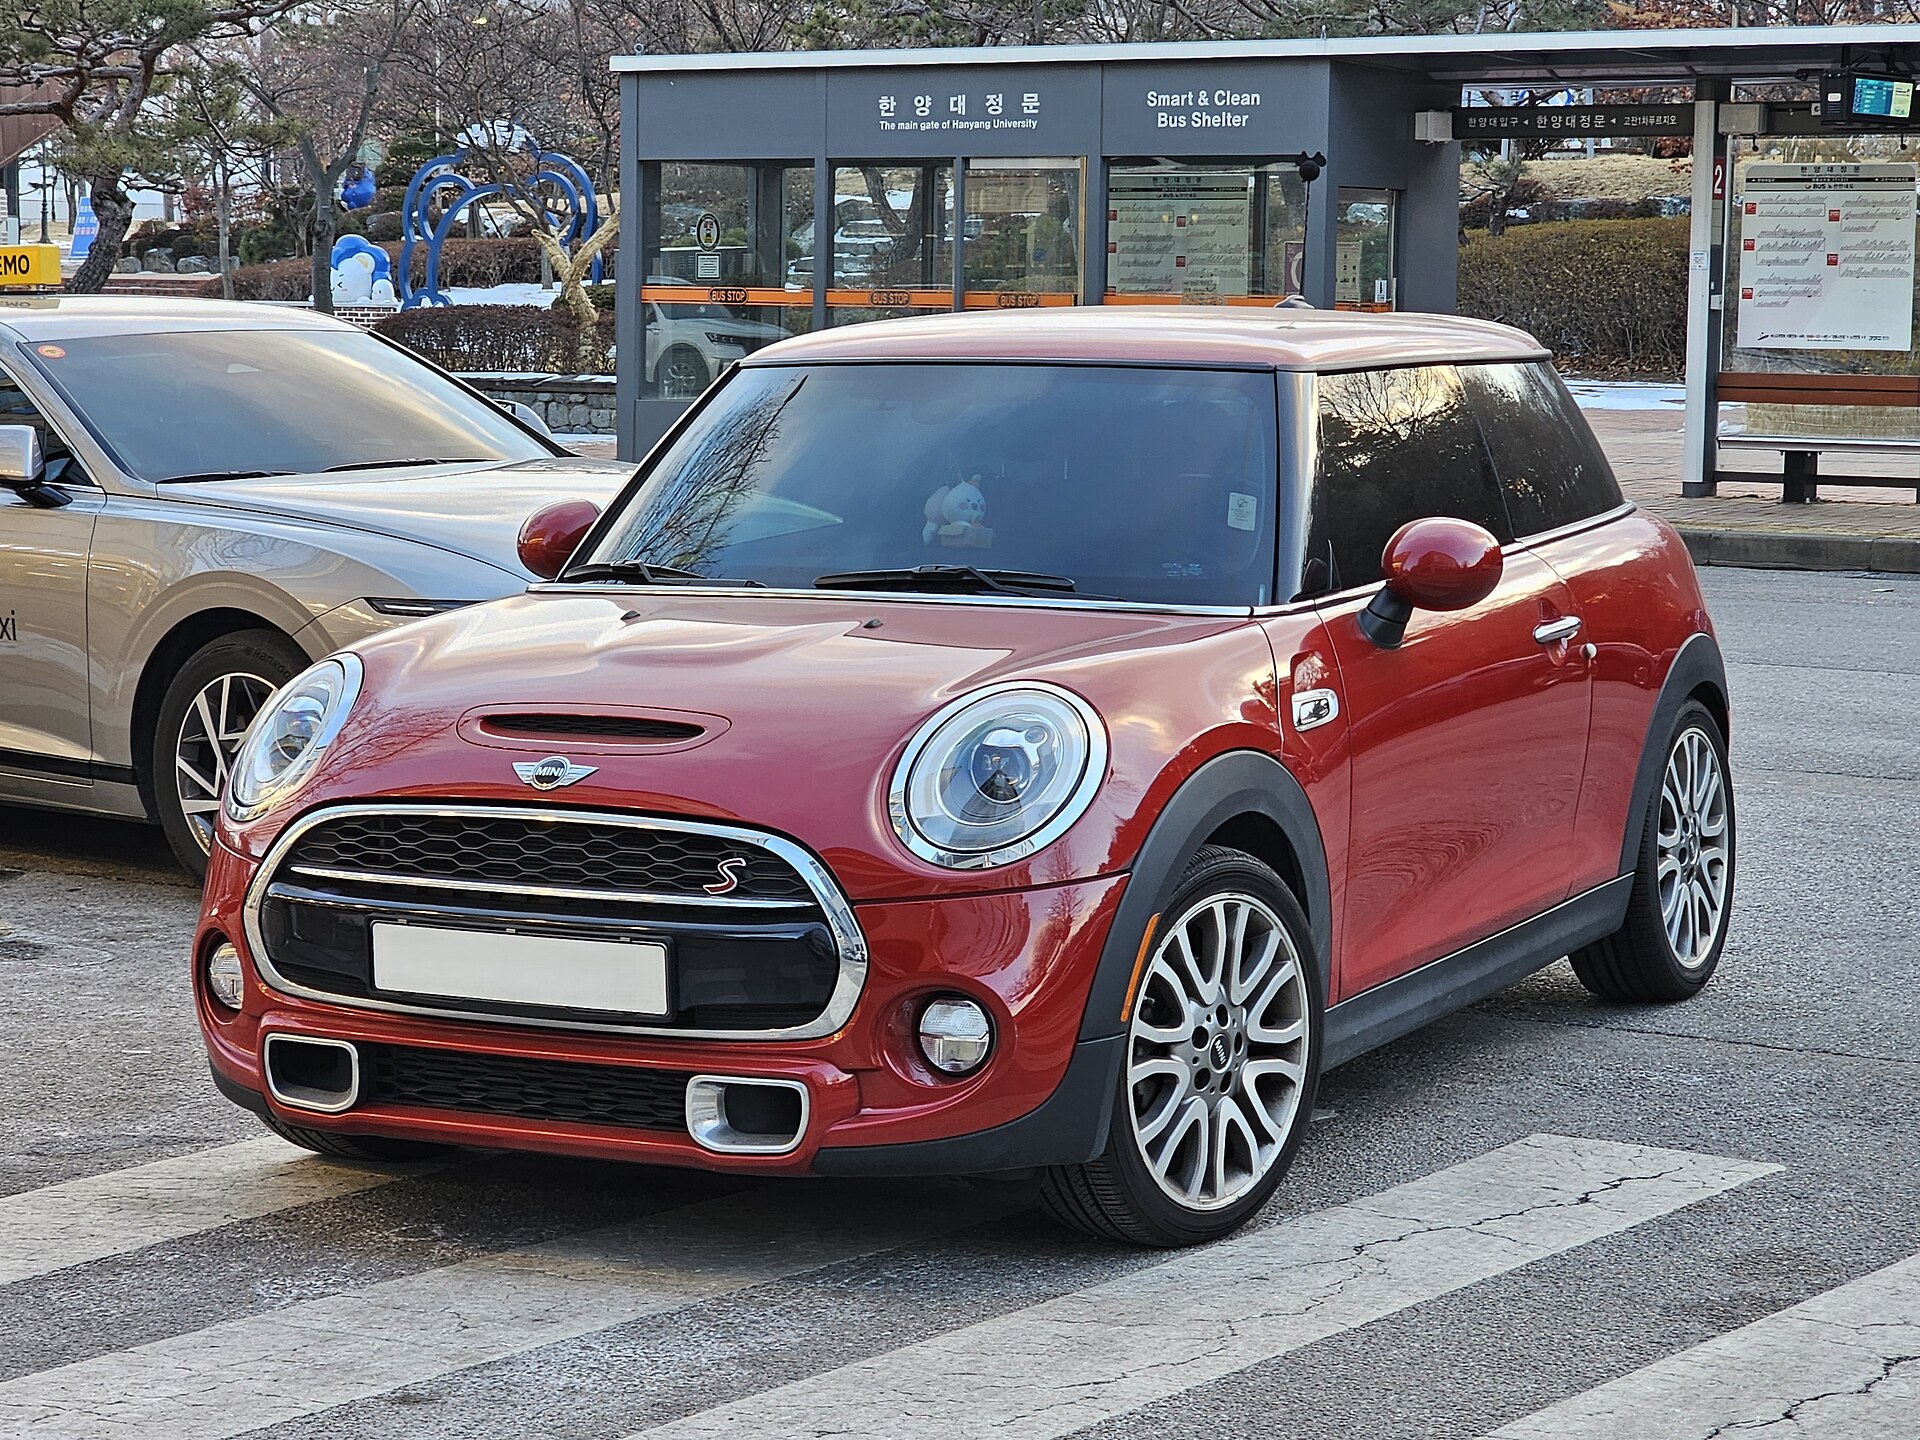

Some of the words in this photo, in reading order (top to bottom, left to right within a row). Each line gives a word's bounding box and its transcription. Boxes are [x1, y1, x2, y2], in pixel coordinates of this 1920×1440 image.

[878, 93, 1040, 117] 한양대정문
[1147, 91, 1194, 106] Smart
[1198, 90, 1210, 106] &
[1214, 90, 1261, 105] Clean
[879, 121, 895, 130] The
[898, 120, 918, 130] main
[920, 120, 939, 131] gate
[942, 119, 951, 129] of
[952, 119, 991, 130] Hanyang
[993, 118, 1038, 129] University
[1157, 112, 1187, 127] Bus
[1191, 111, 1249, 127] Shelter
[1468, 117, 1519, 128] 한양대입구
[1536, 115, 1606, 129] 한양대정문
[1714, 165, 1723, 194] 2
[0, 254, 30, 275] MO
[712, 290, 725, 301] BUS
[727, 290, 745, 301] STOP
[873, 294, 888, 304] BUS
[889, 294, 908, 304] STOP
[1001, 295, 1016, 307] BUS
[1018, 295, 1037, 307] STOP
[534, 766, 564, 777] MINI
[703, 857, 746, 895] S
[1214, 1039, 1227, 1065] MINI
